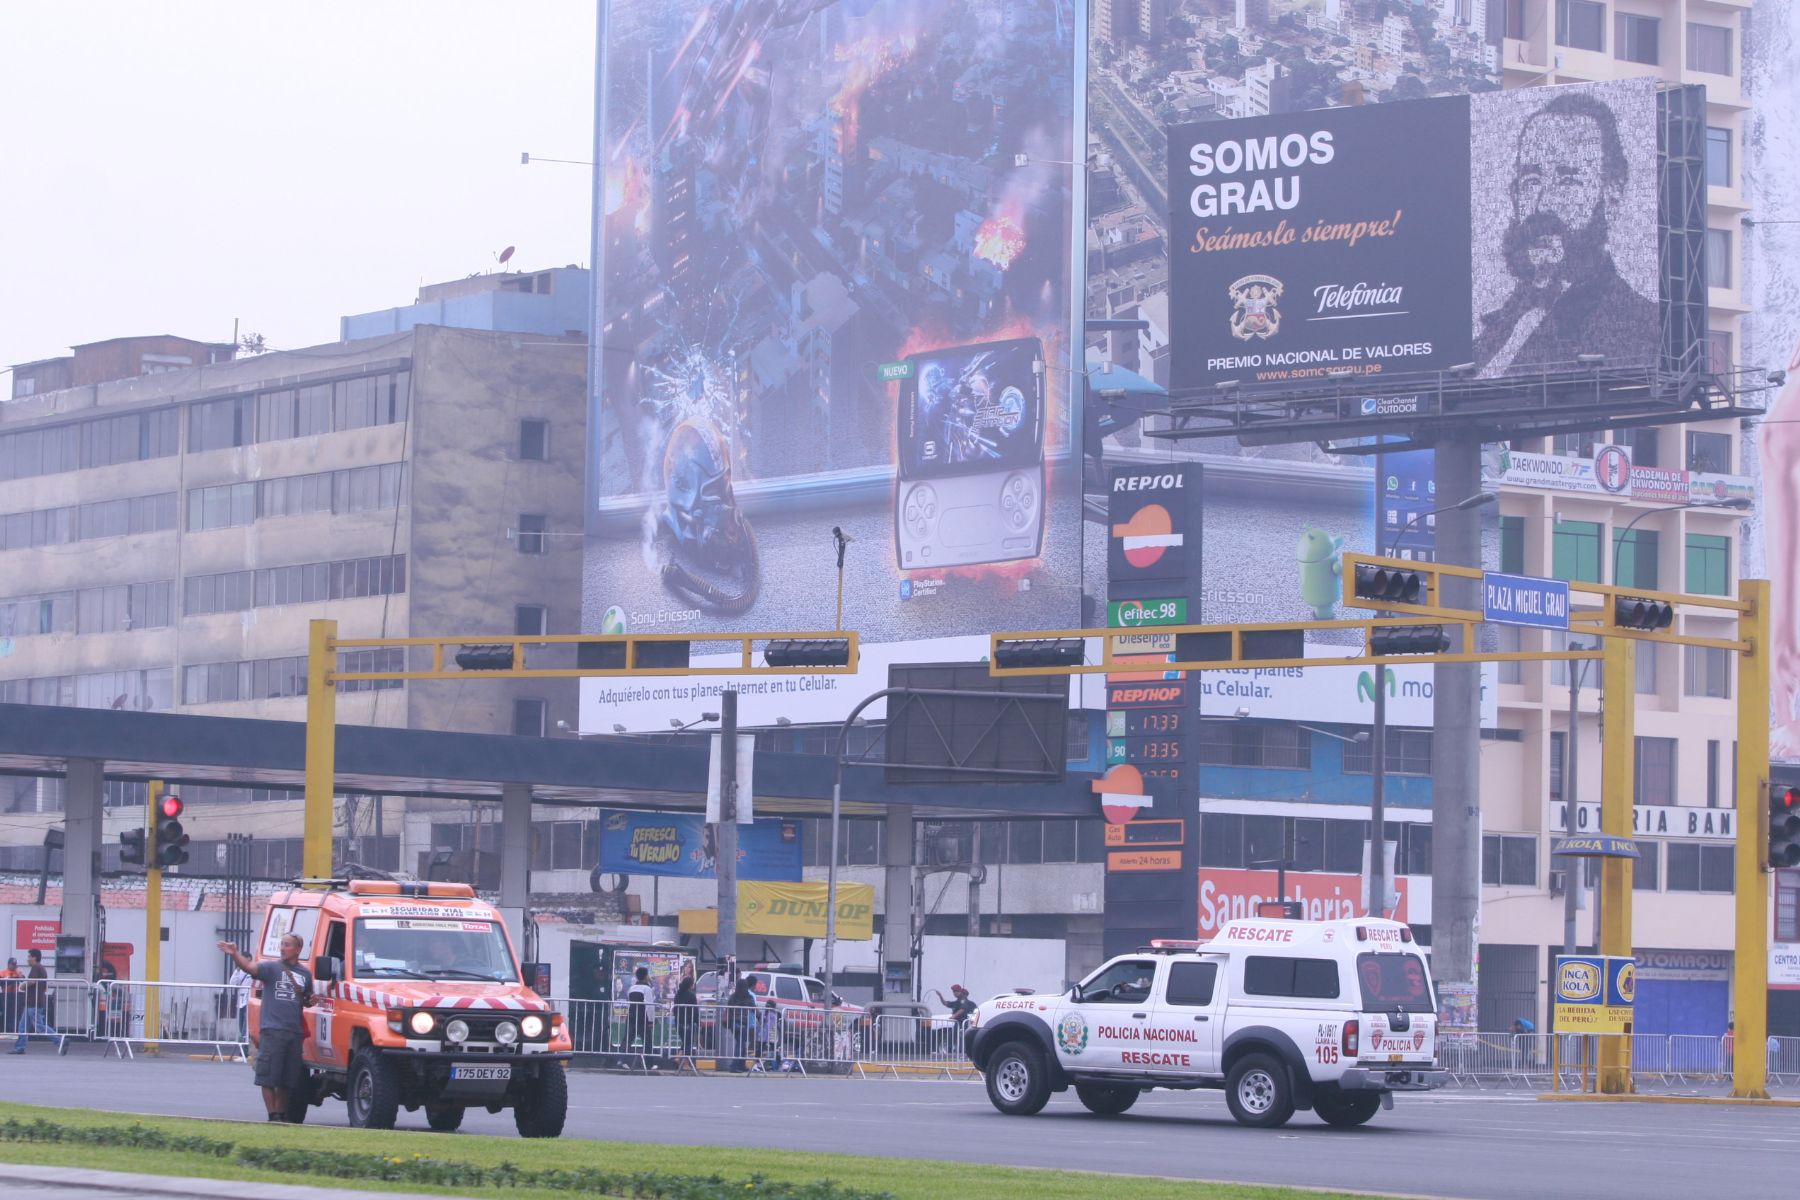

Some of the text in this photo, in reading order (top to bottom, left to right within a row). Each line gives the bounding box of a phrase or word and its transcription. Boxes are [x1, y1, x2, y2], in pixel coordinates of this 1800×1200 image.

[1189, 131, 1335, 177] SOMOS
[1190, 175, 1300, 218] GRAU
[1190, 210, 1403, 253] Seámoslo siempre!
[1207, 342, 1432, 371] PREMIO NACIONAL DE VALORES
[883, 365, 908, 377] NUEVO
[1376, 404, 1417, 414] OUTDOOR
[1512, 457, 1562, 475] TAEKWONDO
[1113, 474, 1184, 491] REPSOL
[1506, 476, 1597, 489] www.grandmastergym.com
[1631, 469, 1681, 482] ACADEMIA DE
[1674, 483, 1689, 493] WTF
[913, 579, 943, 589] PlayStation
[1488, 584, 1565, 618] PLAZA MIGUEL GRAU
[631, 609, 701, 626] Sony Ericsson
[1124, 602, 1176, 620] efitec 98
[599, 675, 838, 707] Adquiérelo con tus planes Internet en tu Celular.
[1112, 688, 1181, 702] REPSHOP
[1216, 679, 1273, 698] Celular.
[1114, 742, 1179, 758] 90 13.35
[633, 827, 676, 843] REFRESCA
[639, 843, 680, 862] VERANO
[1139, 856, 1148, 865] 24
[1150, 856, 1171, 865] horas
[1228, 926, 1294, 942] RESCATE
[1368, 928, 1399, 942] RESCATE
[1774, 954, 1798, 965] CENTRO
[1564, 969, 1589, 979] INCA
[1563, 981, 1590, 991] KOLA
[995, 1001, 1036, 1009] RESCATE
[1098, 1026, 1198, 1043] POLICIA NACIONAL
[1382, 1040, 1411, 1051] POLICIA
[1121, 1052, 1191, 1066] RESCATE
[1315, 1046, 1338, 1064] 105
[458, 1068, 510, 1079] 175 DEY 92
